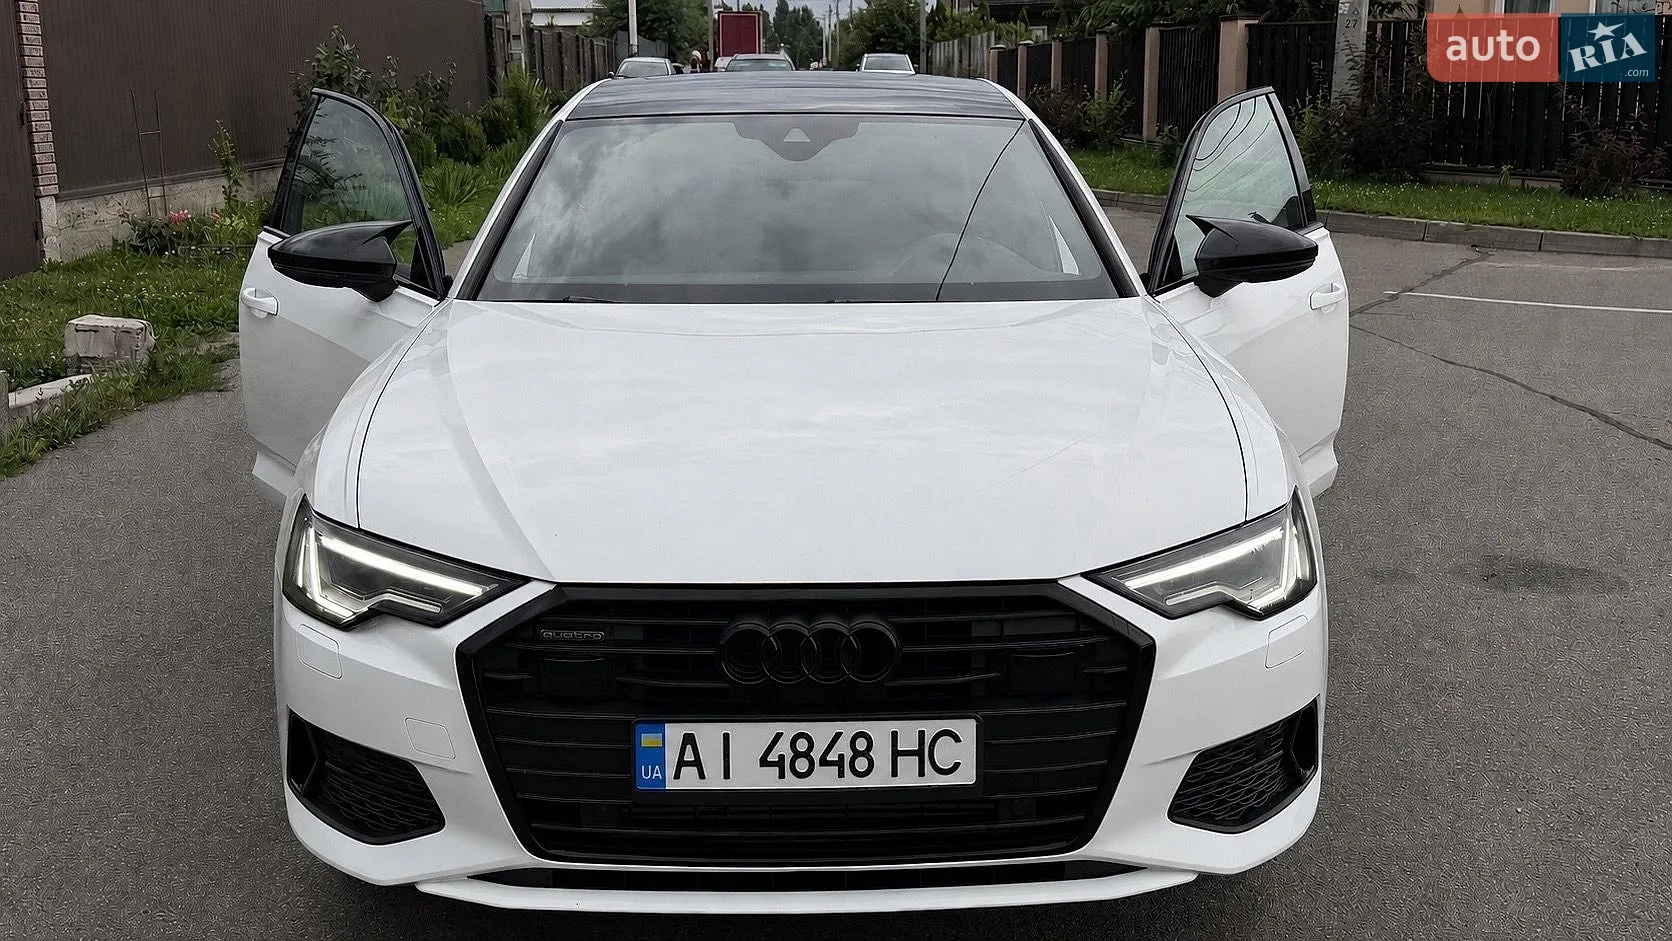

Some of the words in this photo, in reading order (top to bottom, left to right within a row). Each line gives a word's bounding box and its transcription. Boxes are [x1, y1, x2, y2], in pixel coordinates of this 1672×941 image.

[672, 731, 732, 780] AI
[758, 730, 875, 779] 4848
[890, 728, 963, 778] HC
[641, 764, 662, 779] UA
